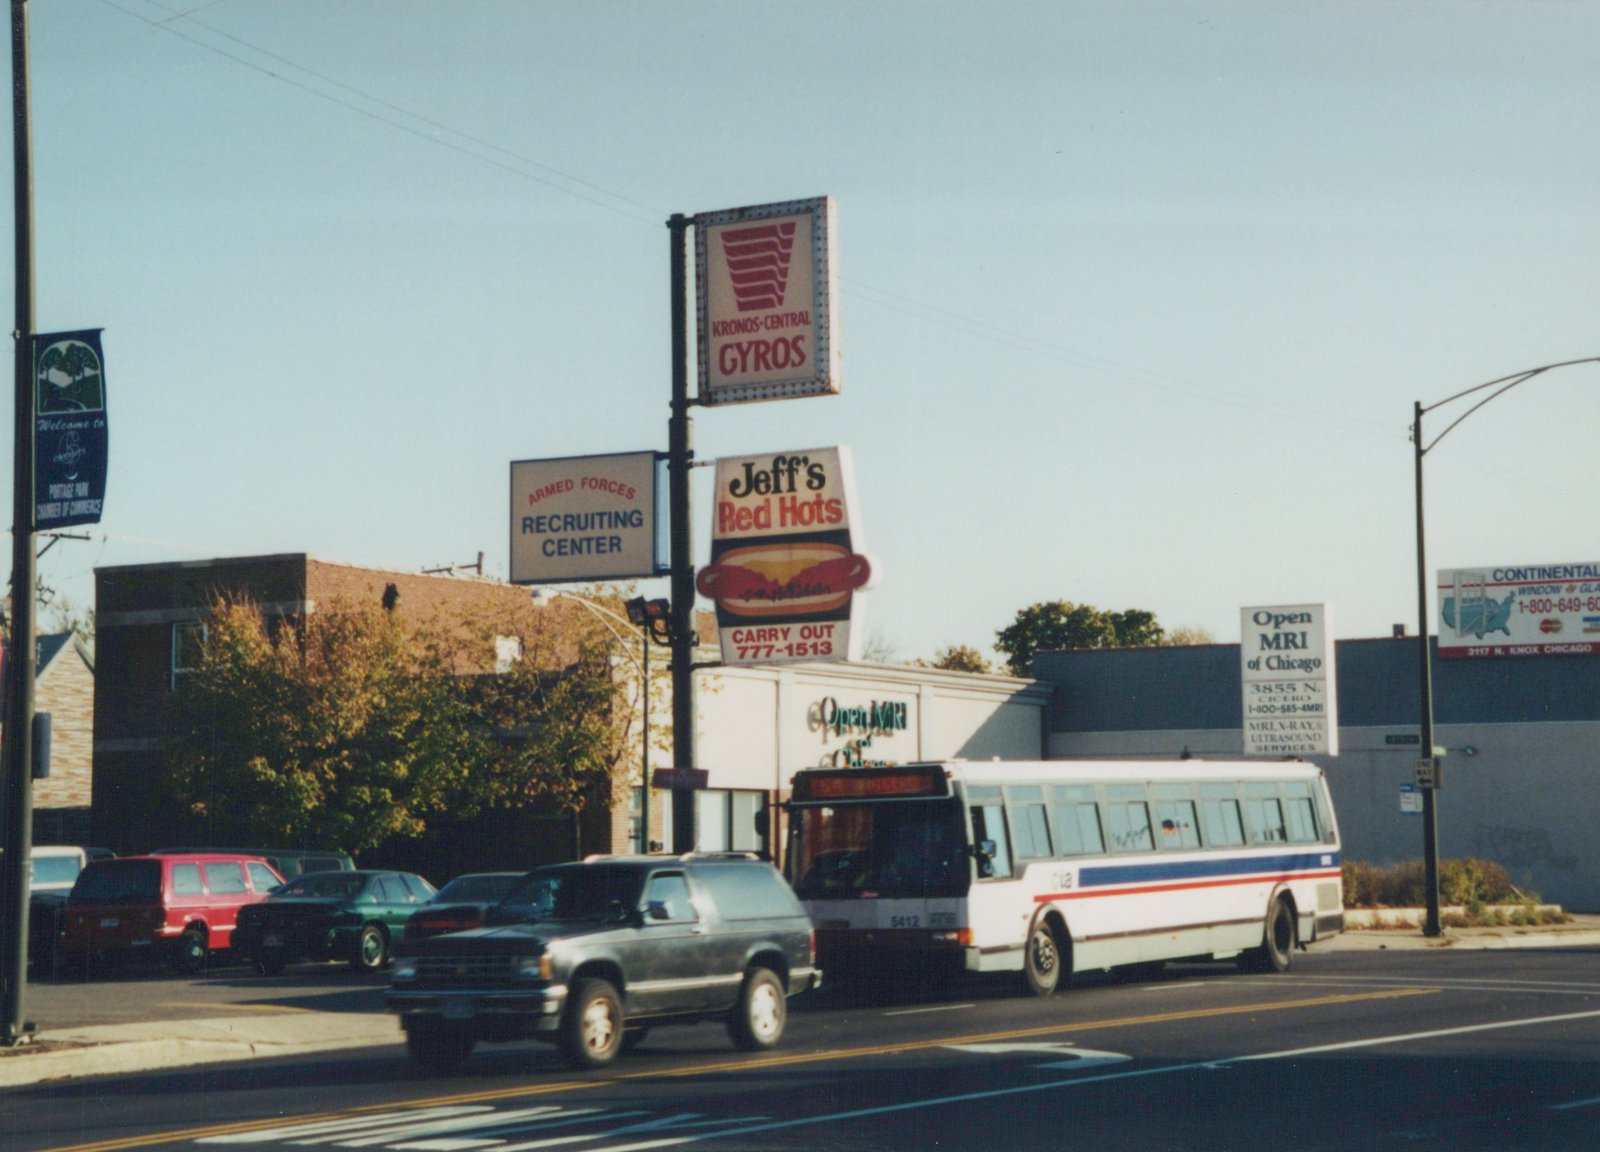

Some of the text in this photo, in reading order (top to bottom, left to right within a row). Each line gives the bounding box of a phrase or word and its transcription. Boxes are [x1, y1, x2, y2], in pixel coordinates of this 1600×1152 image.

[712, 311, 812, 337] KRONOS-CENTRAL
[718, 335, 806, 376] GYROS
[38, 419, 104, 431] Welcome to
[729, 456, 826, 498] Jeff's
[528, 477, 636, 506] ARMED FORCES
[522, 509, 644, 534] RECRUITING
[718, 493, 843, 533] Red Hots
[542, 536, 622, 557] CENTER
[1492, 565, 1600, 582] CONTINENTAL
[1518, 585, 1562, 596] WINDOW
[1253, 611, 1312, 629] Open
[731, 624, 835, 643] CARRY OUT
[1259, 632, 1309, 650] MRI
[736, 641, 833, 659] 777-1513
[1467, 648, 1489, 656] 3117
[1509, 646, 1538, 654] KNOX
[1544, 644, 1592, 653] CHICAGO
[1247, 655, 1321, 673] of Chicago
[1250, 683, 1297, 694] 3855
[820, 697, 907, 737] Open MRI
[1250, 733, 1322, 743] ULTRASOUND
[890, 915, 920, 927] 5412
